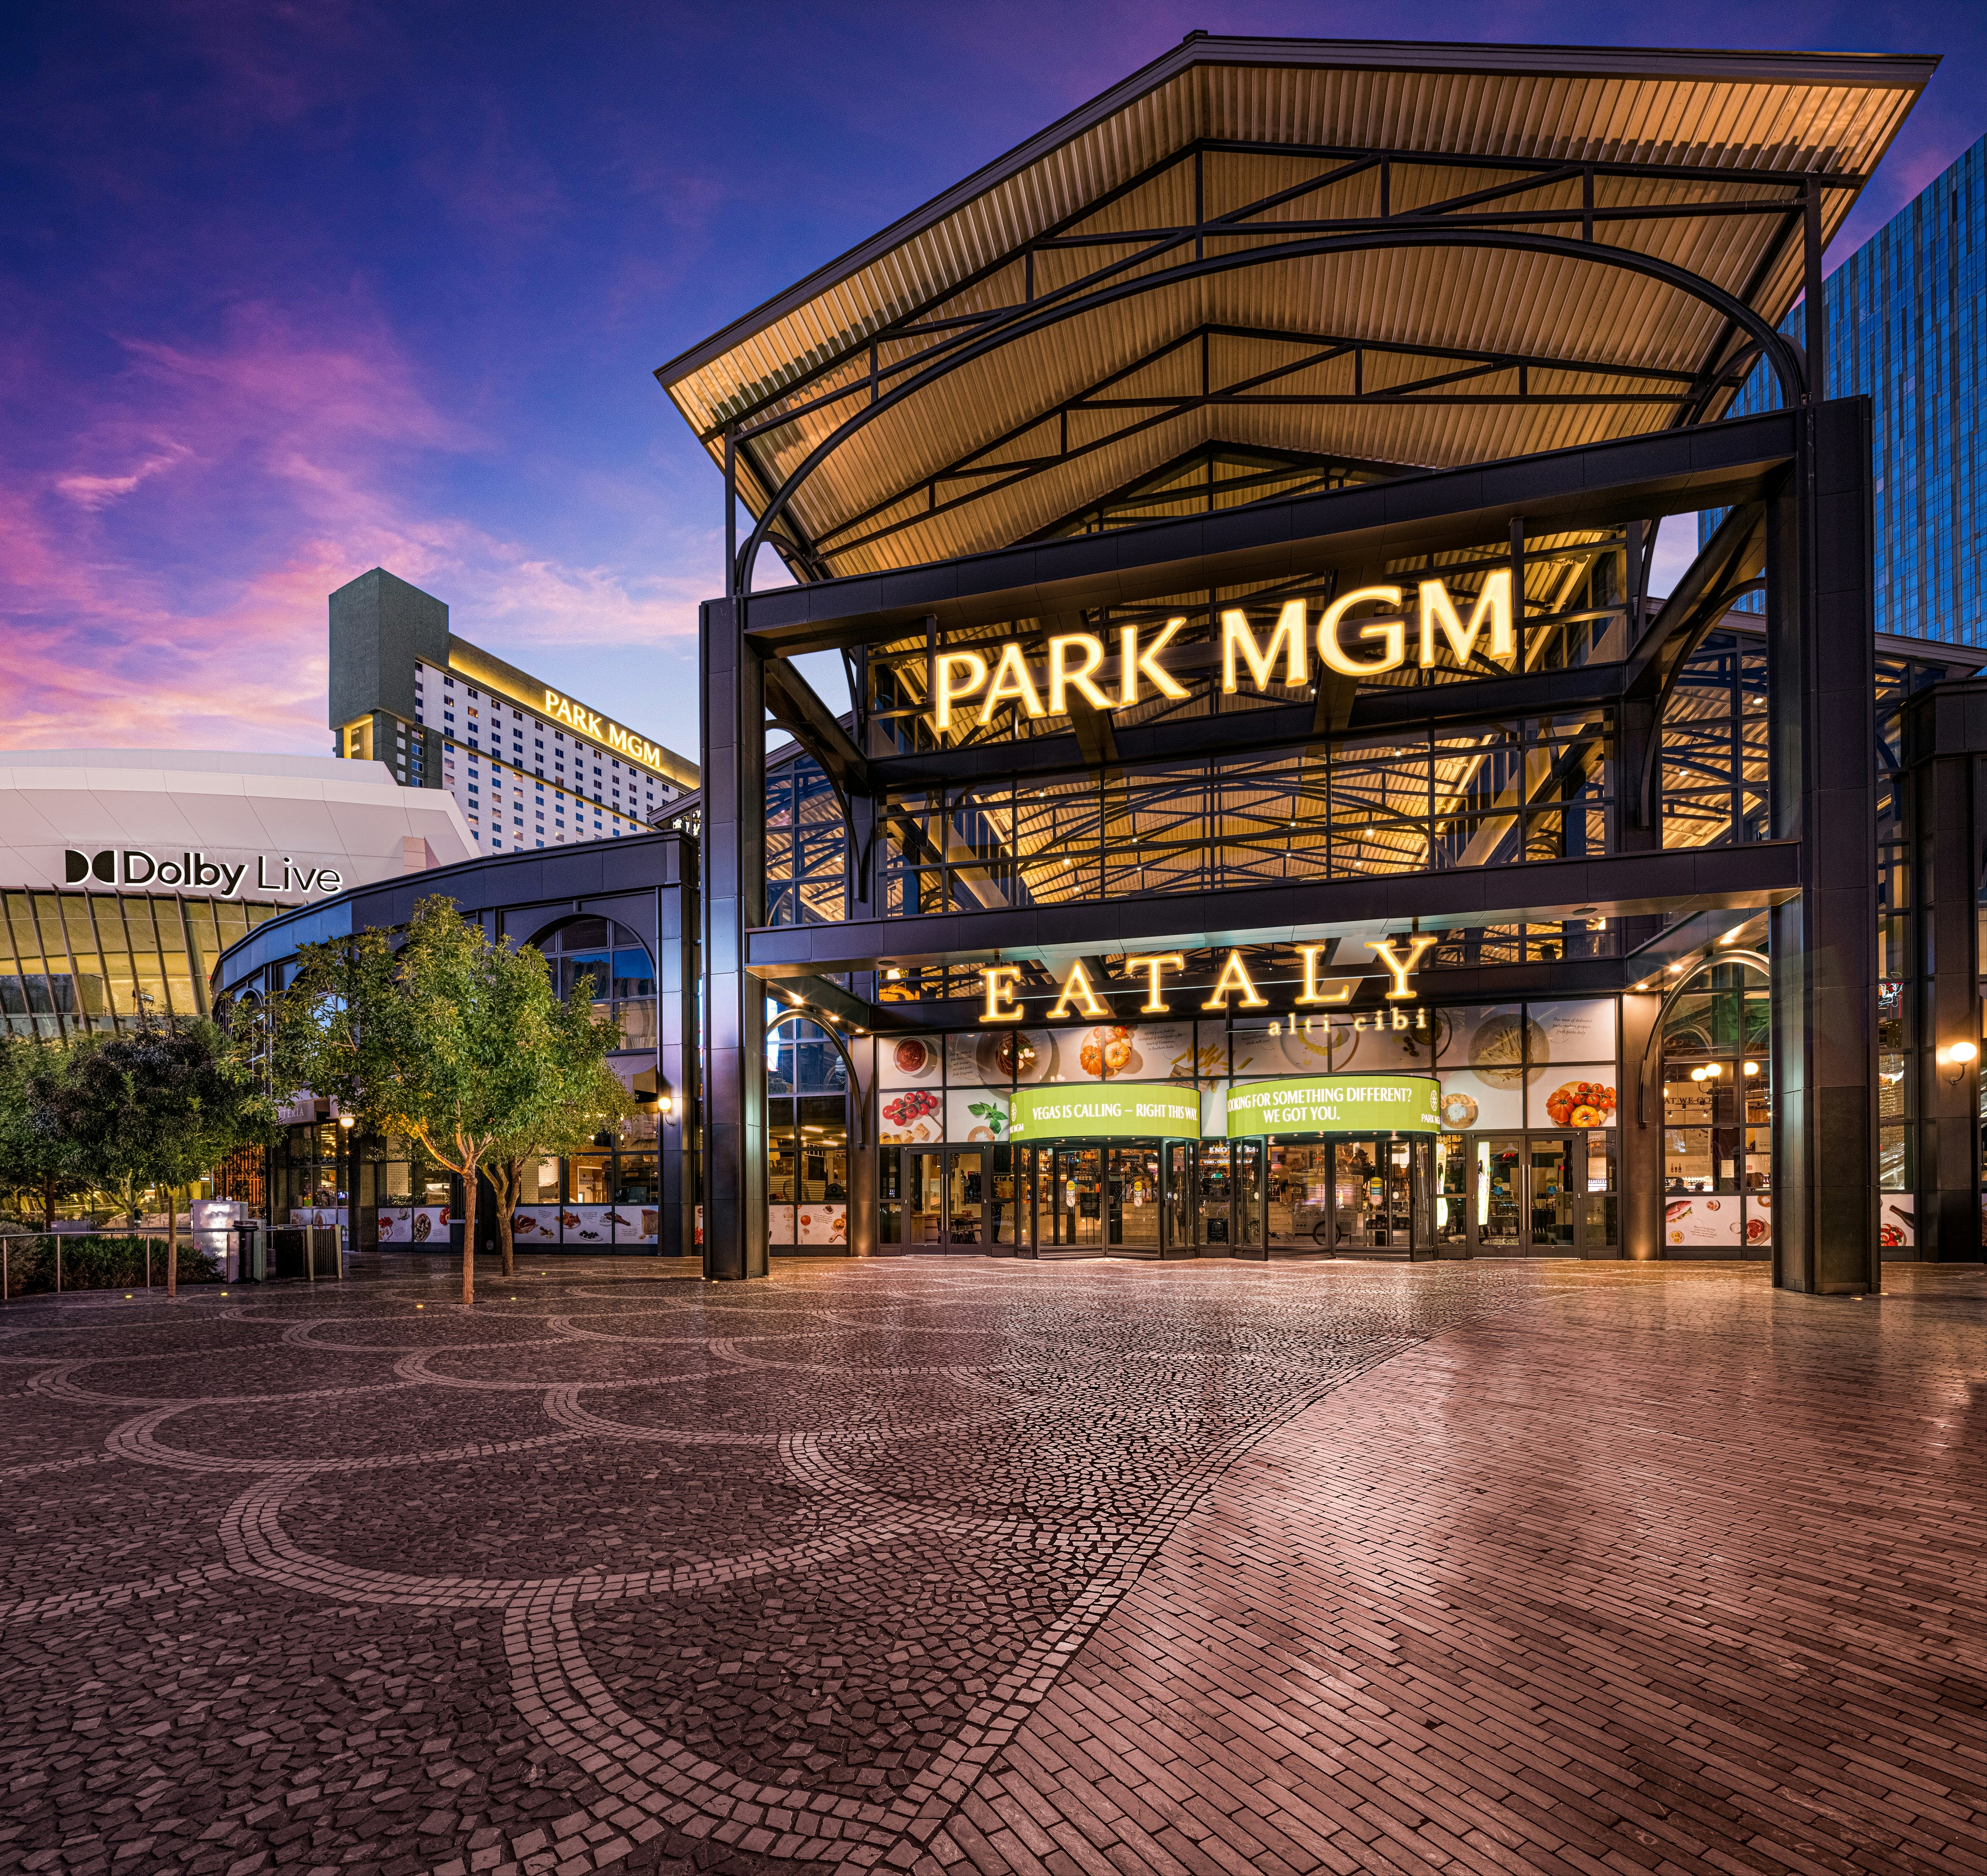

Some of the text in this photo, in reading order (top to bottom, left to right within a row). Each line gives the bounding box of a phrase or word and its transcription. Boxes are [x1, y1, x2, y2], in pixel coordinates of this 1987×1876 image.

[935, 568, 1514, 731] PARK MGM
[545, 690, 660, 767] PARK MGM
[124, 851, 343, 898] Dolby Live
[979, 937, 1438, 1022] EATALY
[1268, 1007, 1426, 1036] alti cibi
[1033, 1105, 1061, 1120] VEGAS
[1063, 1104, 1072, 1118] IS
[1074, 1104, 1122, 1118] CALLING
[1136, 1104, 1167, 1118] RIGHT
[1168, 1105, 1185, 1119] THIS
[1185, 1107, 1198, 1122] WAY.
[1227, 1087, 1412, 1112] LOOKING FOR SOMETHING DIFFERENT?
[1263, 1106, 1341, 1123] WE GOT YOU.
[1421, 1113, 1435, 1123] PARK
